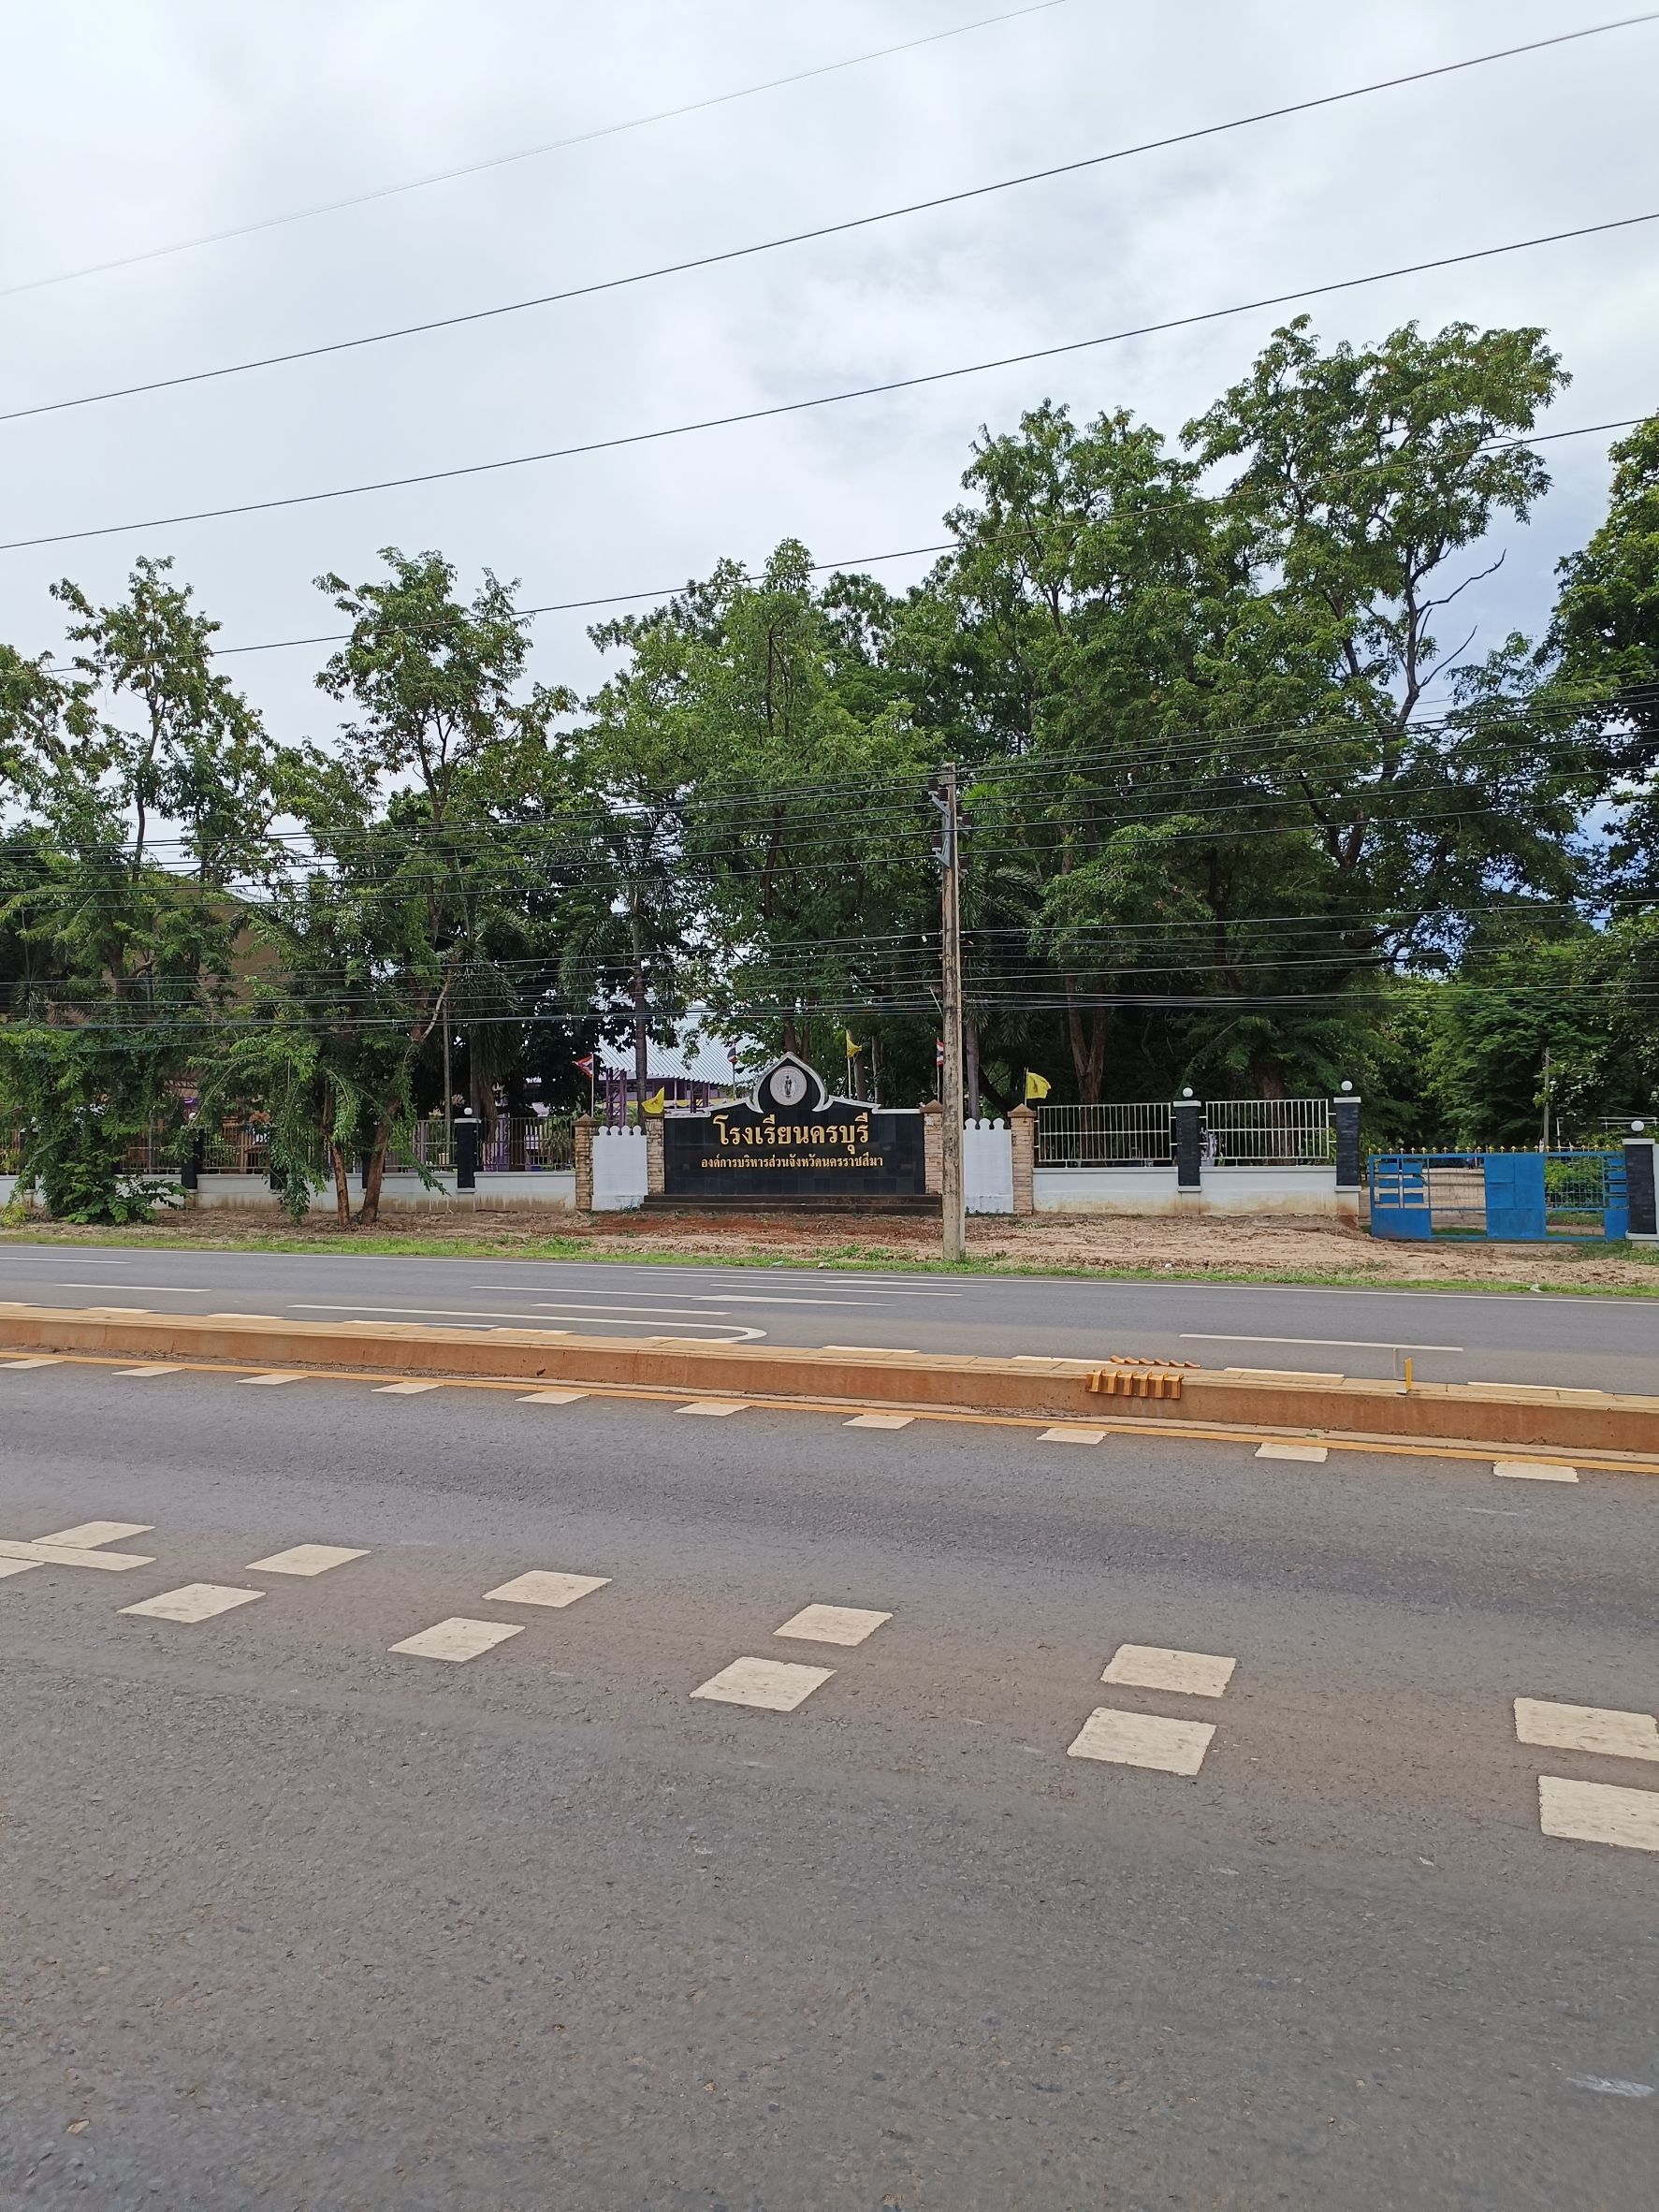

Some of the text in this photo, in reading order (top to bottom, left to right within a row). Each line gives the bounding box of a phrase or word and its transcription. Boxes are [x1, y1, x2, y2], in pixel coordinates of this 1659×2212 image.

[713, 1113, 868, 1154] โรงเรียนครบุรี
[702, 1152, 883, 1168] องค์การบริหารส่วนจังหวัดนครราชสีมา
